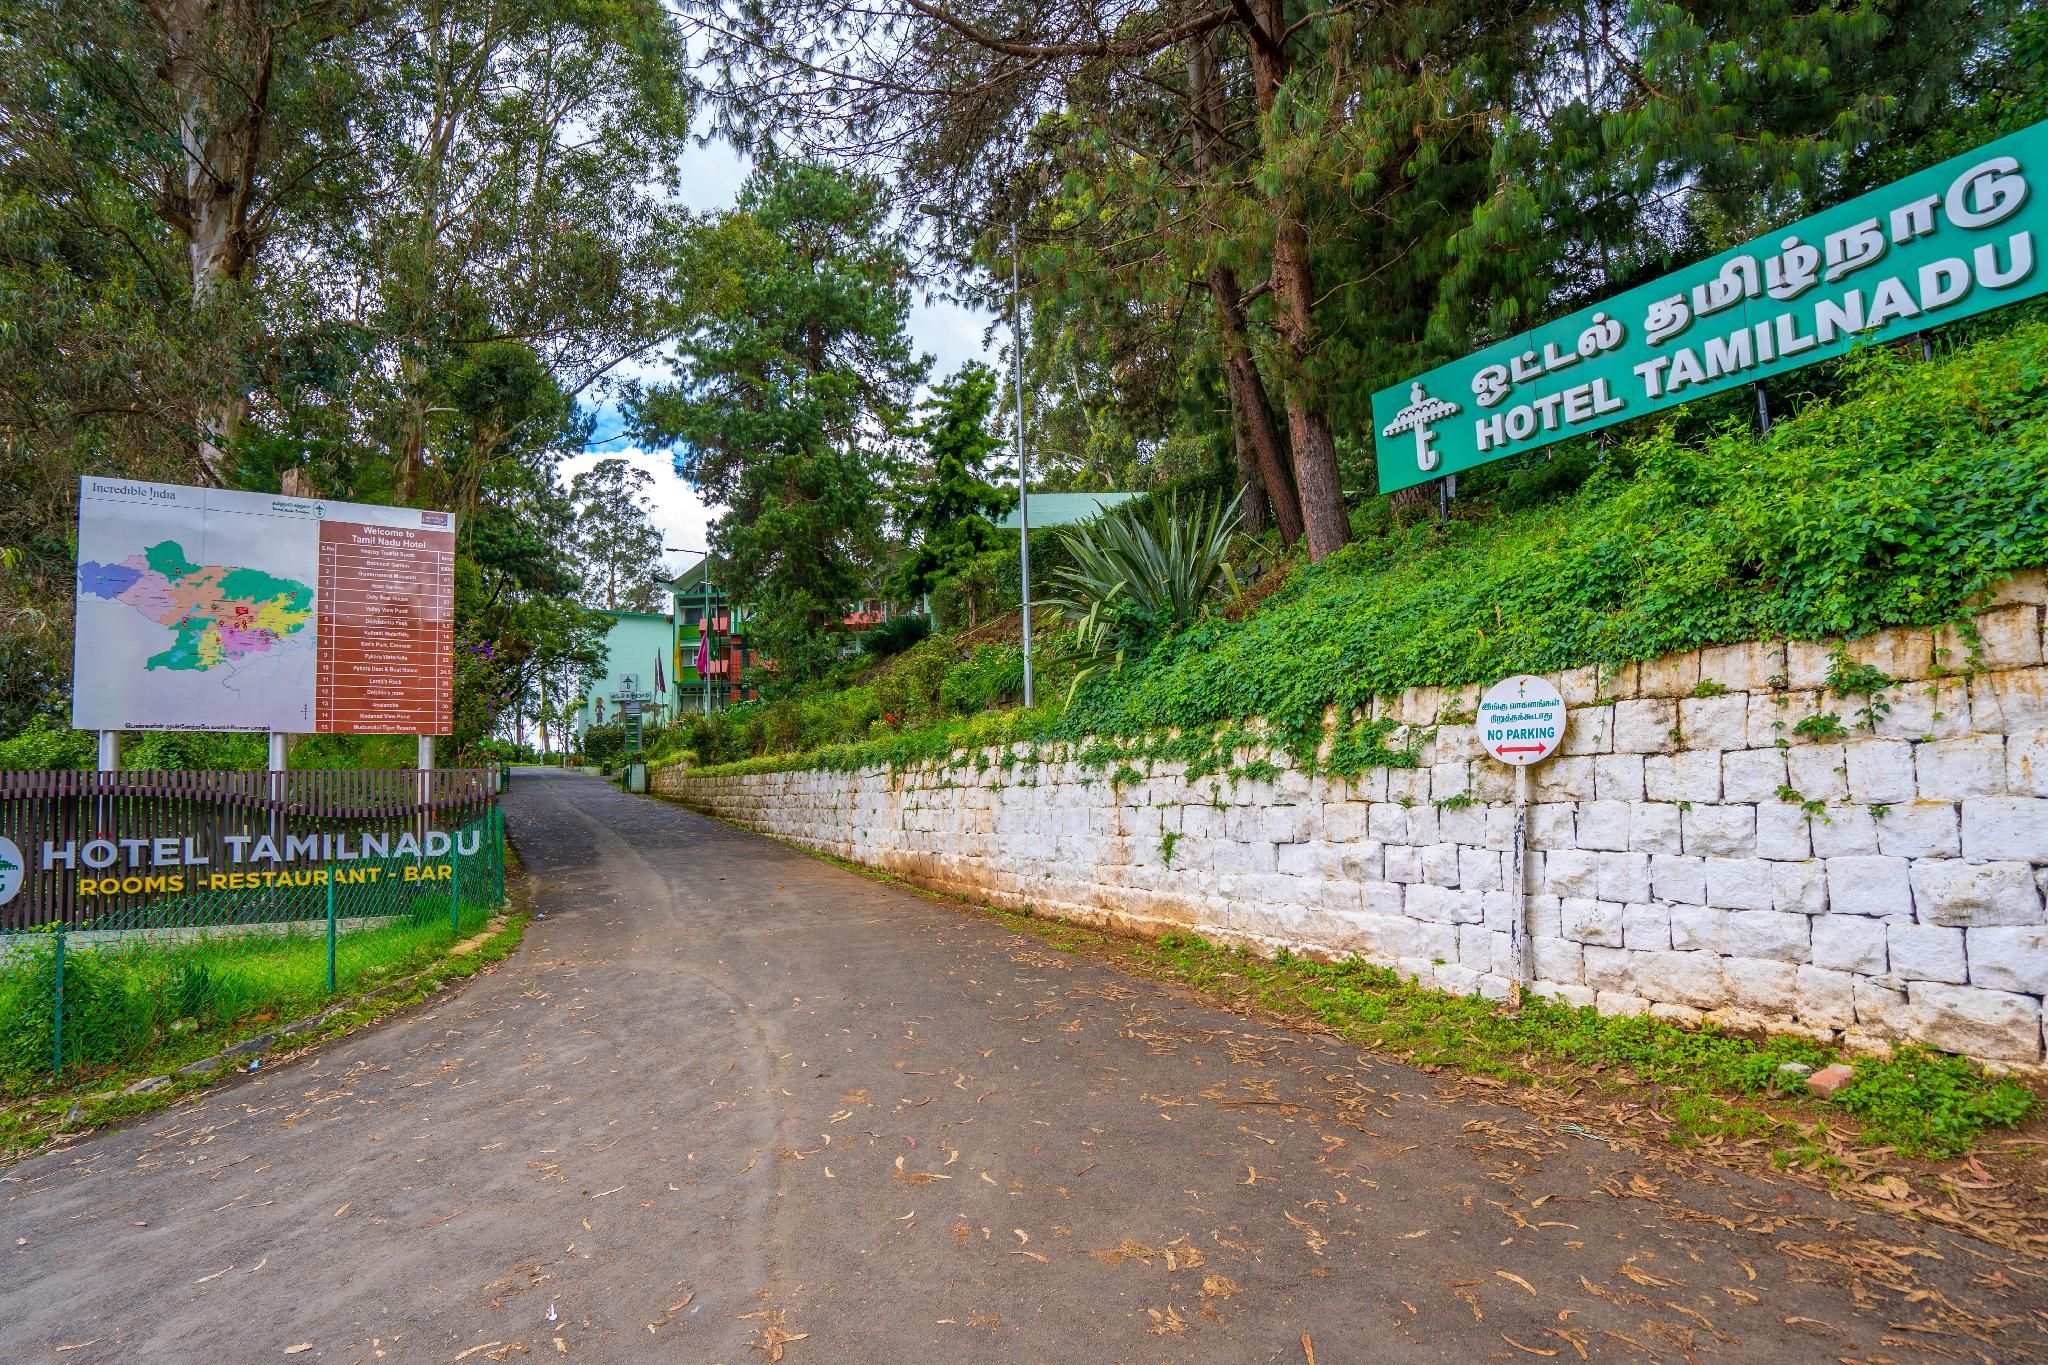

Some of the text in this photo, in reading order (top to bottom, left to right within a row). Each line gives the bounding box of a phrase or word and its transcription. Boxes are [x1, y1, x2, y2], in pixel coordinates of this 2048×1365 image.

[1643, 156, 2029, 346] தமிழ்நாடு
[1475, 230, 2034, 451] HOTEL TAMILNADU
[92, 482, 147, 496] Incredible
[363, 526, 403, 536] Welcome
[352, 534, 426, 549] Tamil Nadu Hotel
[360, 548, 379, 557] Nearby
[366, 606, 380, 614] Valley
[1481, 698, 1560, 711] இங்கு வாகனங்கள்
[1487, 726, 1555, 741] NO PARKING
[42, 829, 480, 871] HOTEL TAMILNADU
[79, 874, 184, 896] ROOMS
[404, 864, 453, 882] BAR
